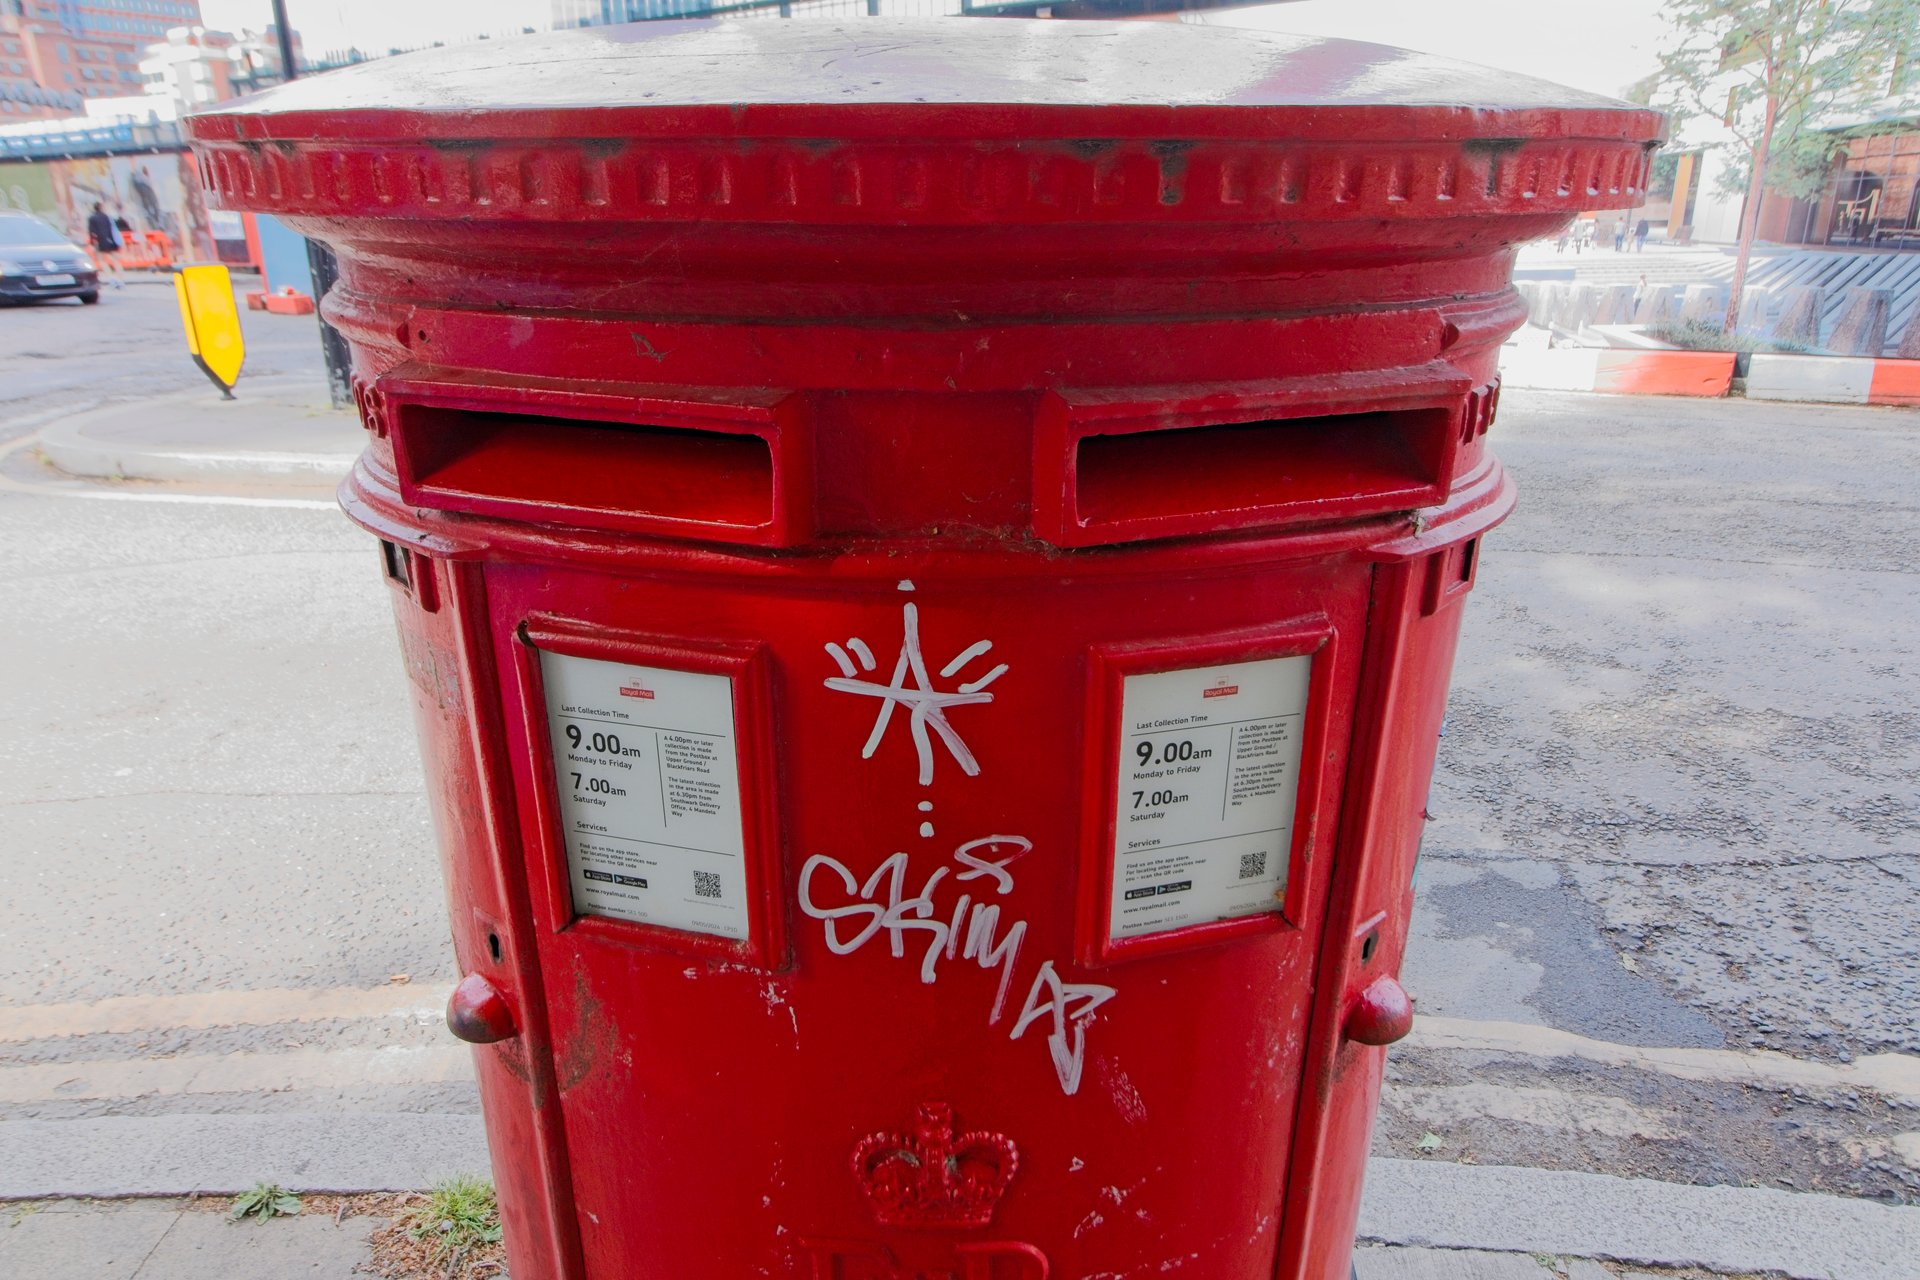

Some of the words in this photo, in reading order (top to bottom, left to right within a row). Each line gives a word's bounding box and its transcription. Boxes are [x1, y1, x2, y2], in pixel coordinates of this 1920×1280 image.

[621, 688, 638, 696] Royal
[1205, 689, 1222, 697] Royal
[561, 704, 576, 712] Last
[578, 706, 610, 716] Collection
[612, 711, 629, 719] Time
[1154, 718, 1188, 727] Collection
[565, 724, 640, 757] 9.00am
[669, 736, 692, 744] 4.00pm
[1136, 741, 1212, 766] 9.00am
[567, 753, 596, 765] Monday
[609, 759, 632, 770] Friday
[683, 758, 702, 766] Ground
[667, 763, 695, 771] Blackfriars
[1133, 771, 1164, 780] Monday
[570, 772, 626, 796] 7.00am
[676, 791, 698, 799] 6.30pm
[1132, 790, 1188, 809] 7.00am
[572, 794, 606, 807] Saturday
[670, 797, 698, 805] Southwark
[699, 801, 720, 810] Delivery
[694, 807, 716, 815] Mandela
[1130, 812, 1165, 822] Saturday
[576, 820, 607, 832] Services
[1128, 839, 1160, 848] Services
[589, 850, 609, 859] locating
[584, 886, 639, 900] www.royalmail.com
[1124, 901, 1180, 914] www.royalmail.com
